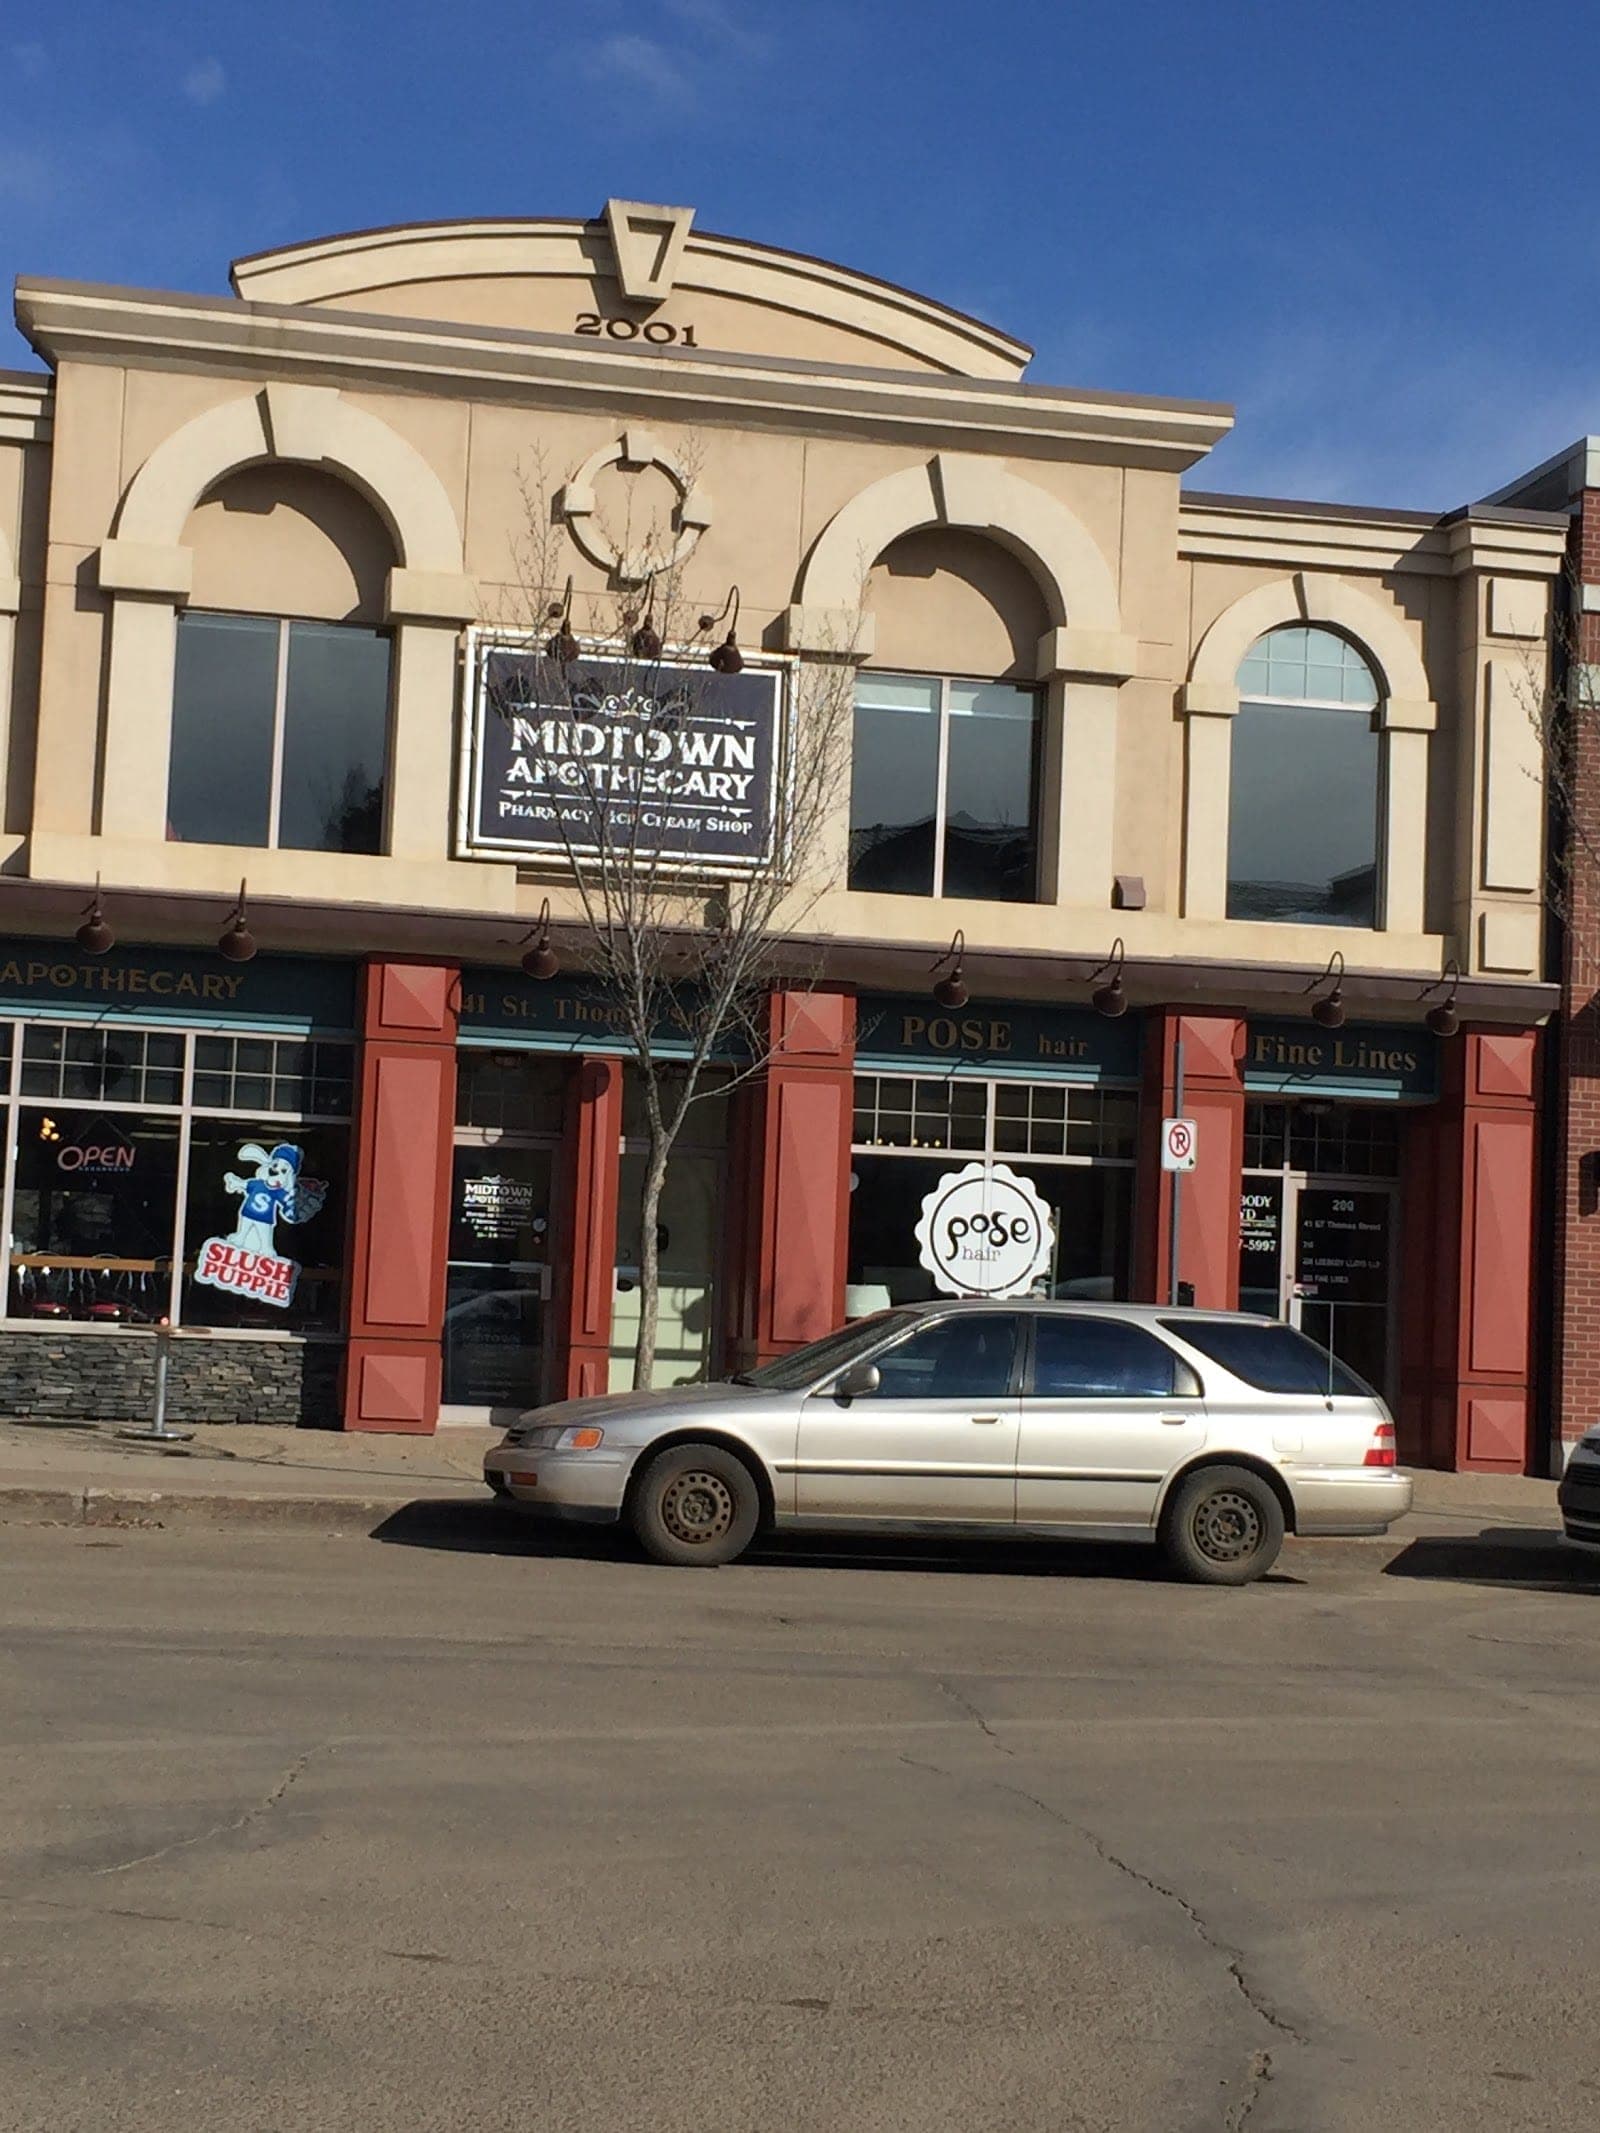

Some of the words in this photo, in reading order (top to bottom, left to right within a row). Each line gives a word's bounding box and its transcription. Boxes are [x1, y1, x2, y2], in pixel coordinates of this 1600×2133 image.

[574, 312, 697, 347] 2001
[511, 717, 756, 769] MIDTOWN
[507, 757, 755, 800] APOTHECARY
[706, 816, 753, 835] SHOP
[0, 960, 244, 1000] APOTHECARY
[502, 994, 537, 1018] St.
[900, 1015, 1012, 1051] POSE
[1038, 1034, 1089, 1056] hair
[1253, 1035, 1323, 1066] Fine
[1333, 1041, 1418, 1072] Lines
[57, 1146, 136, 1171] OPEN
[465, 1183, 533, 1197] MIDTOWN
[945, 1210, 1031, 1261] pose
[962, 1246, 1001, 1261] hair
[206, 1242, 295, 1284] SLUSH
